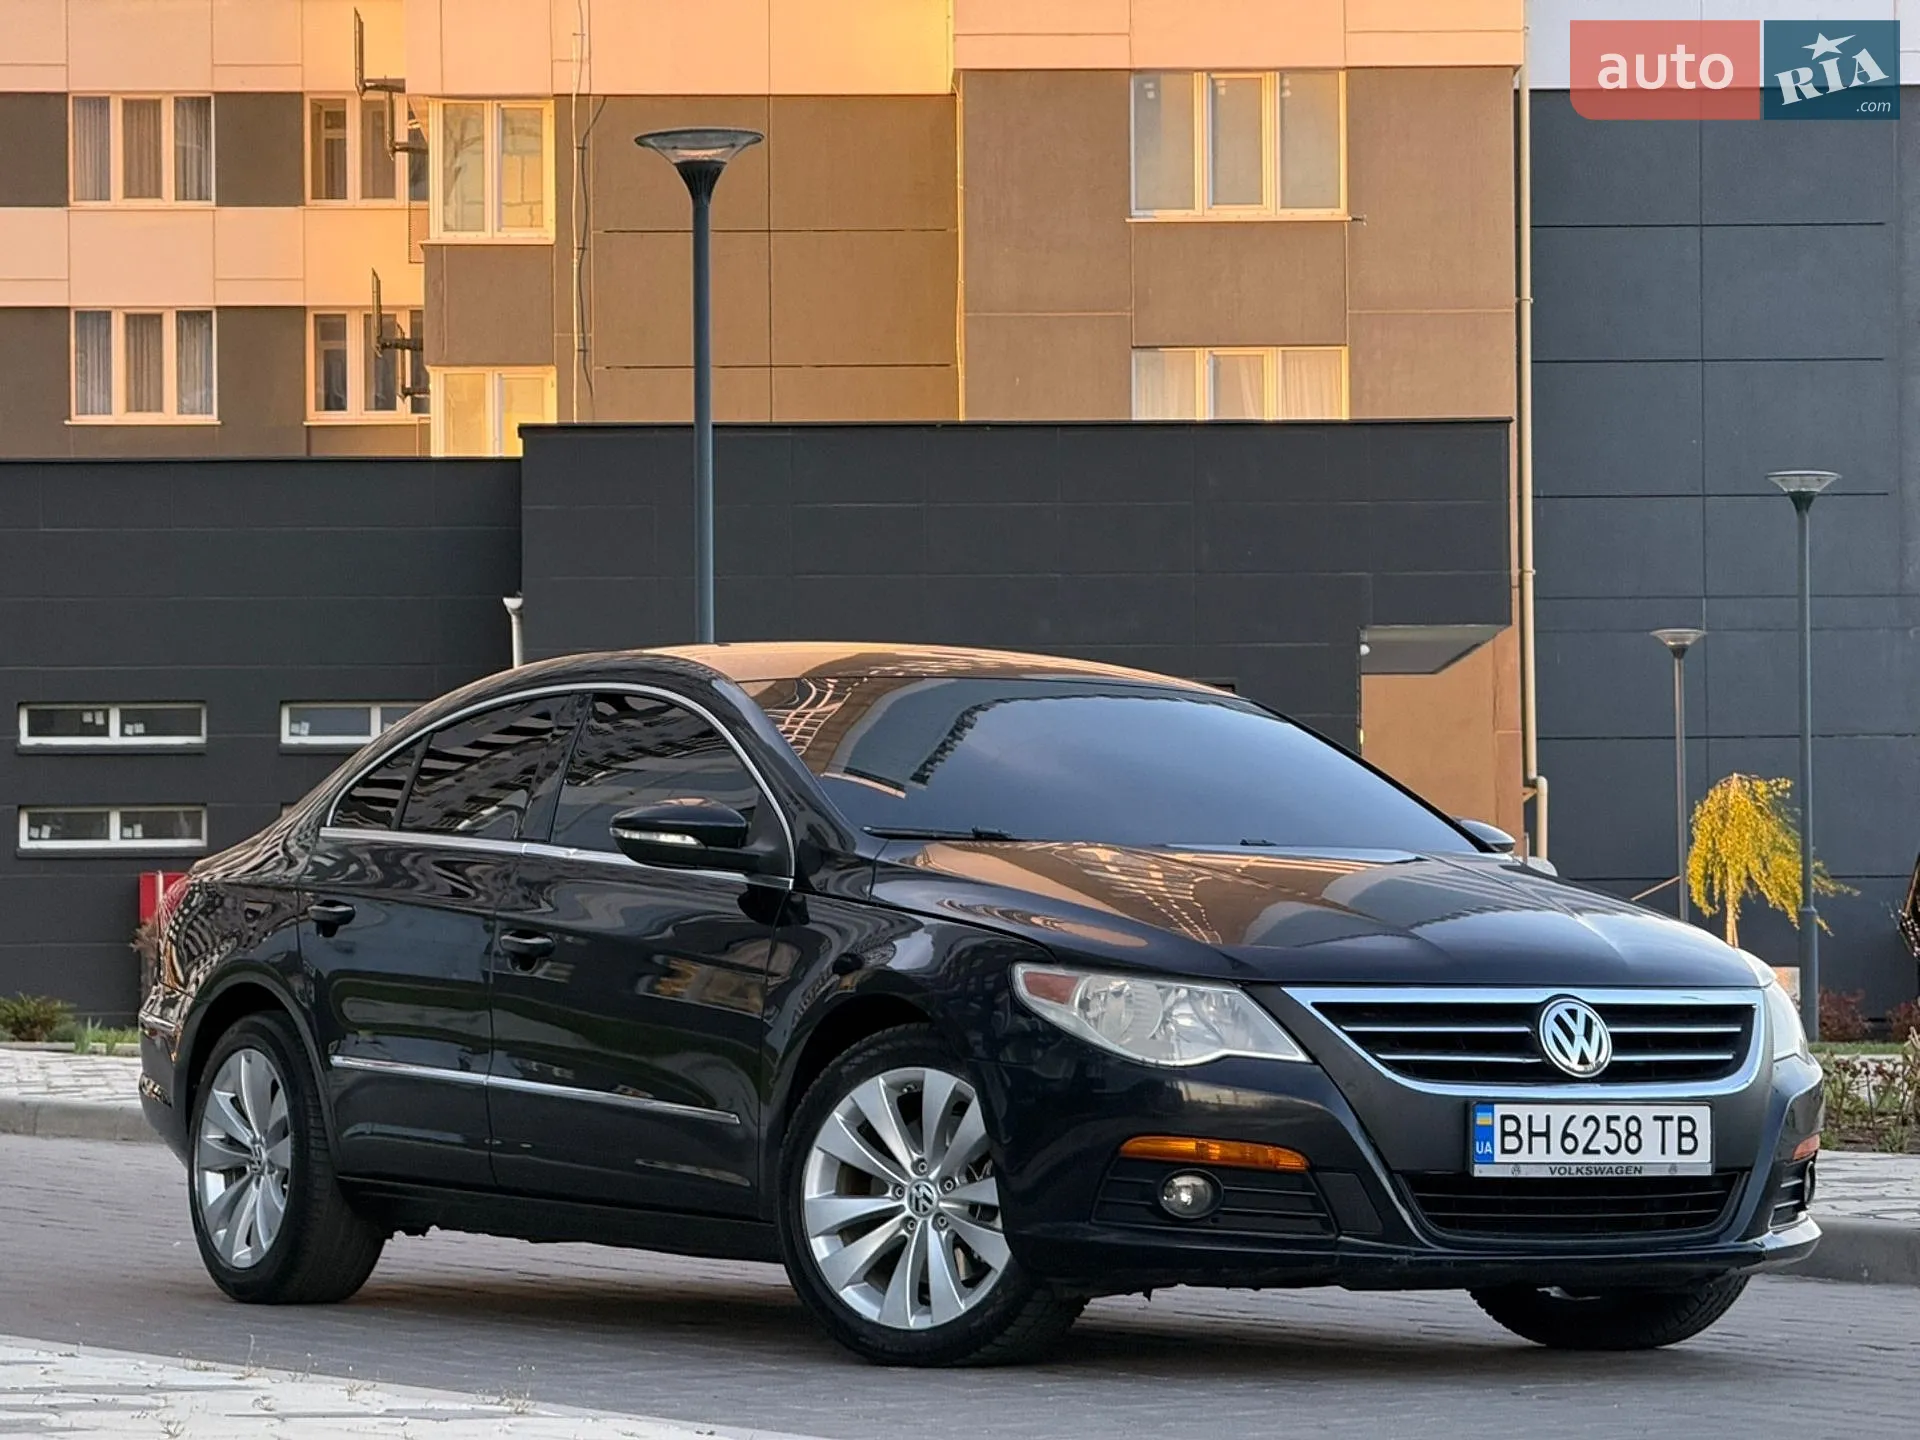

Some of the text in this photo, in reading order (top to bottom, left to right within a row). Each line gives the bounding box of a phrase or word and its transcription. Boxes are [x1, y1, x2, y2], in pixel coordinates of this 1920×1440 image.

[1500, 1114, 1699, 1155] BH 6258 TB
[1475, 1141, 1493, 1154] UA
[1549, 1165, 1643, 1176] VOLKSWAGEN
